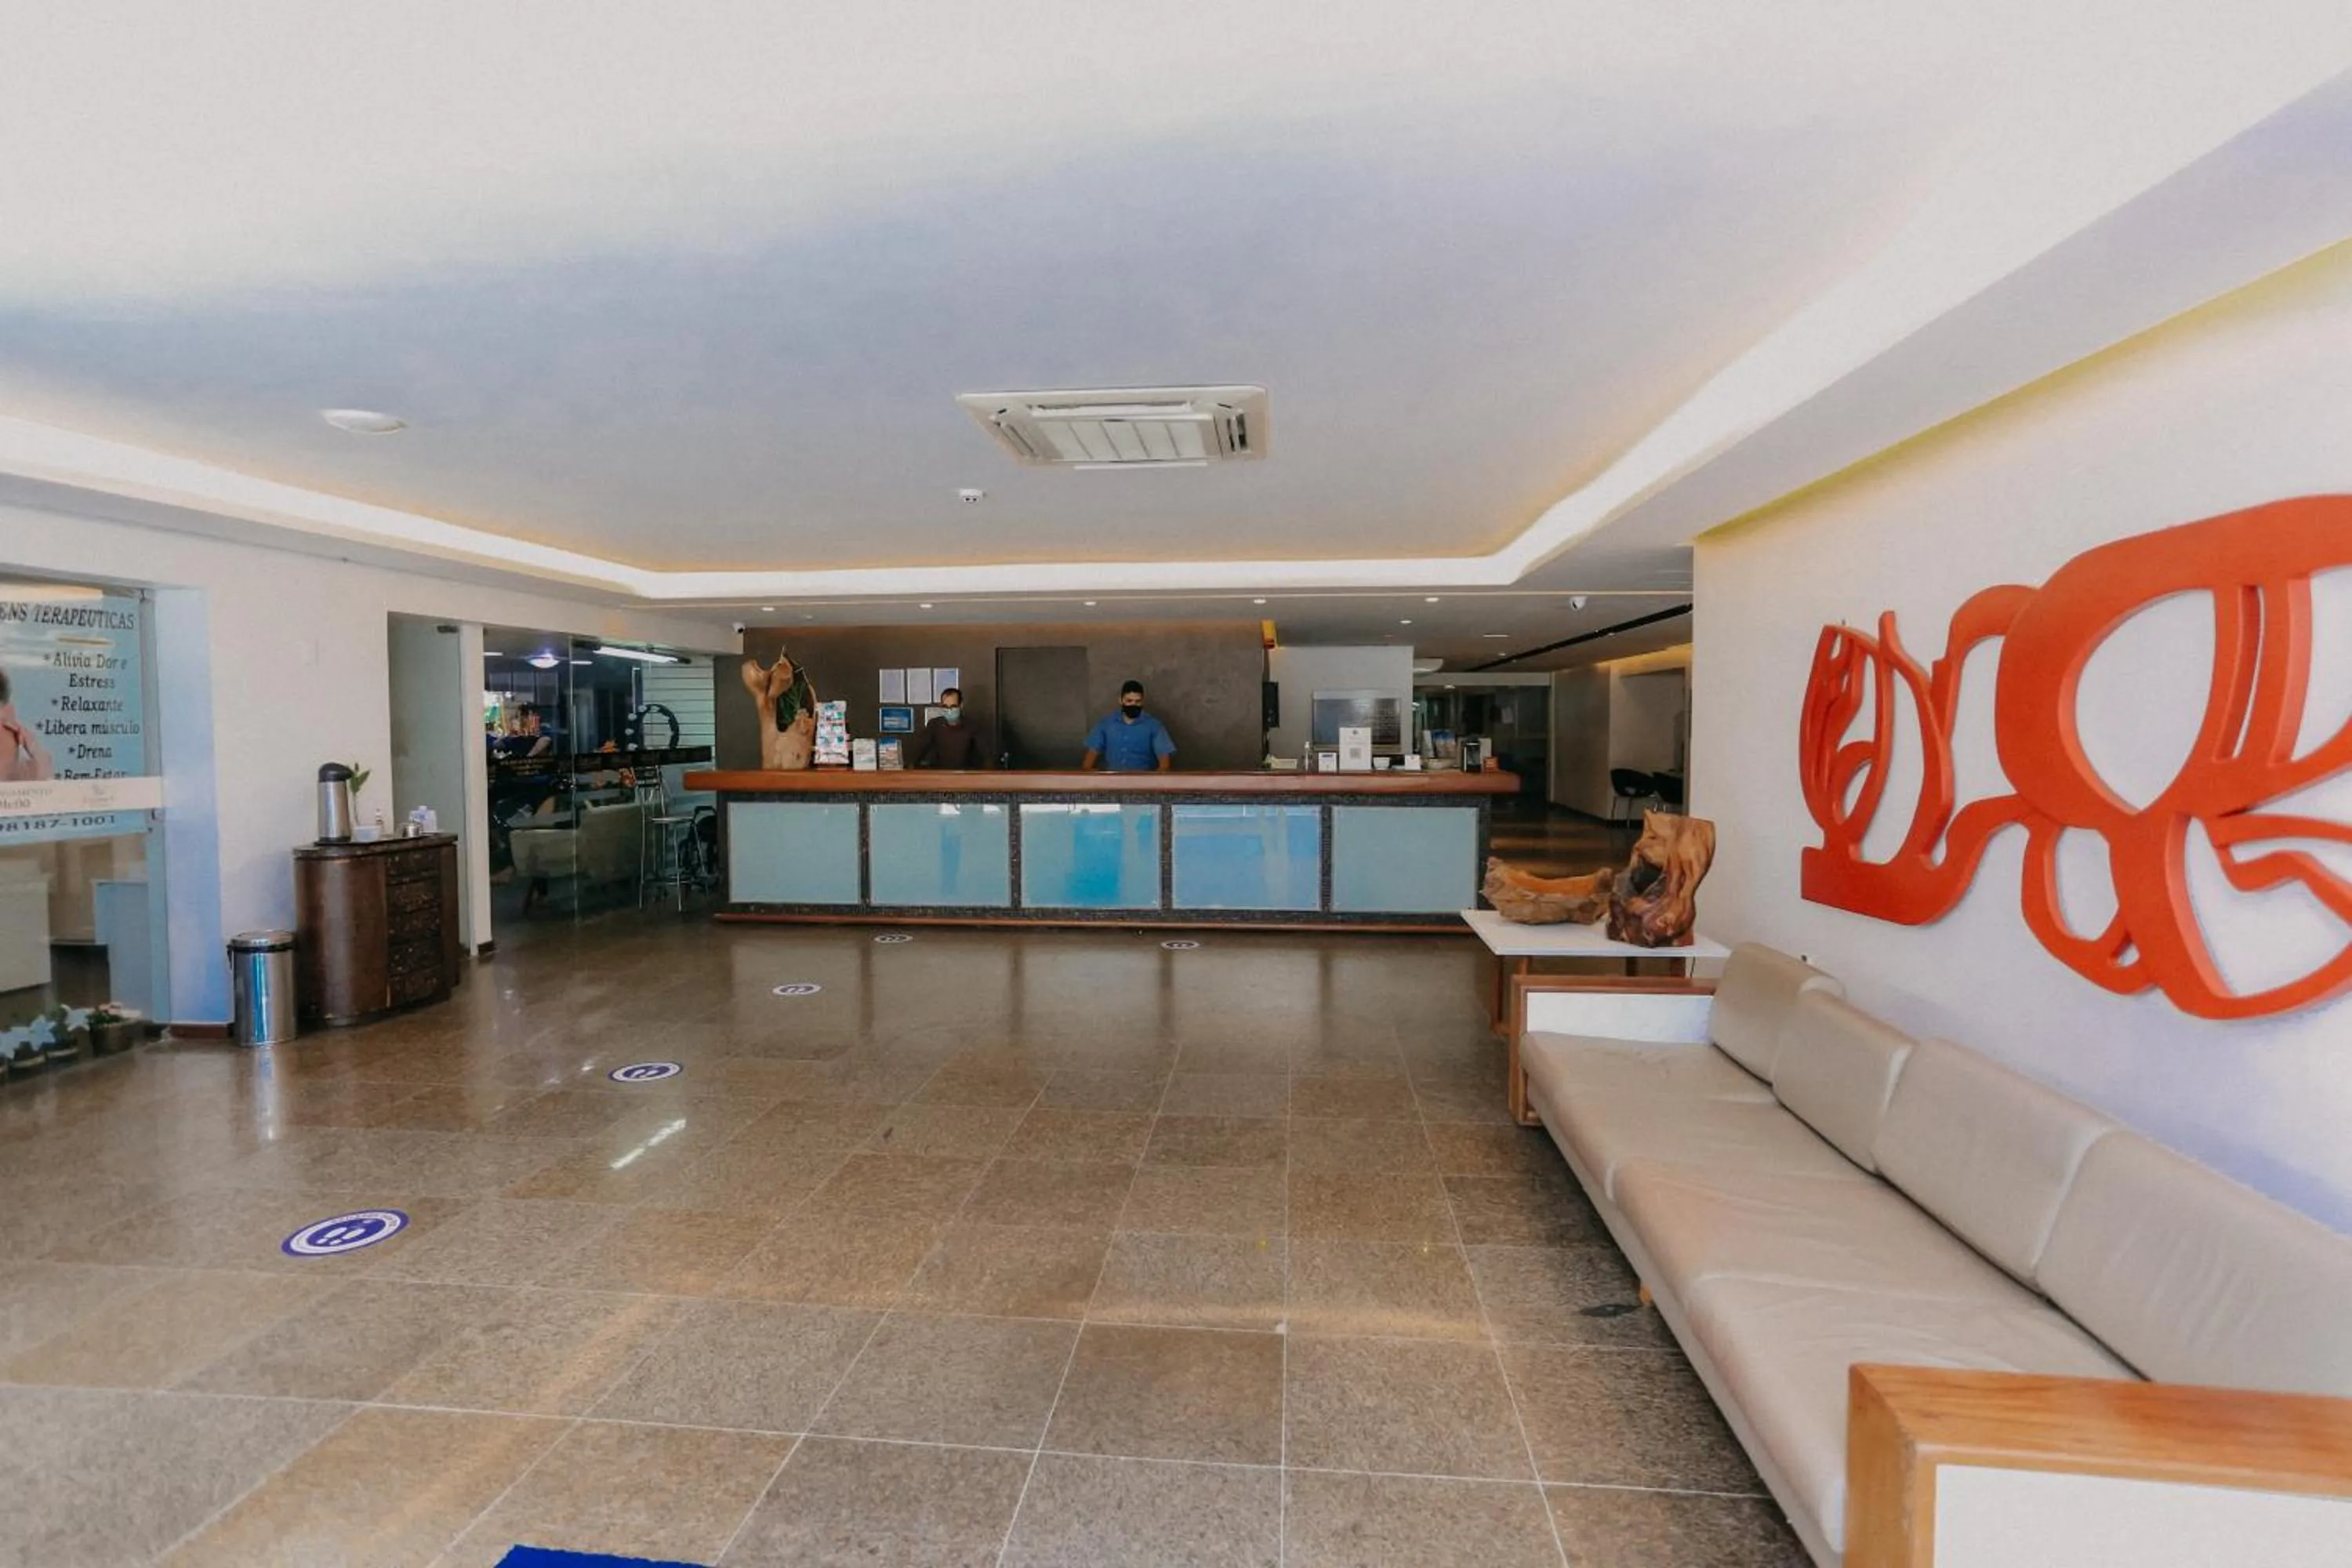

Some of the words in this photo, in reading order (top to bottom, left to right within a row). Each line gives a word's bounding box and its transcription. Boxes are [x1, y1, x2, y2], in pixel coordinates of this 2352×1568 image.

[53, 652, 91, 667] Alivia
[96, 653, 119, 669] Dor
[69, 673, 115, 689] Estress
[60, 695, 123, 712] Relaxante
[44, 718, 88, 735] Libera
[76, 743, 113, 759] Drena
